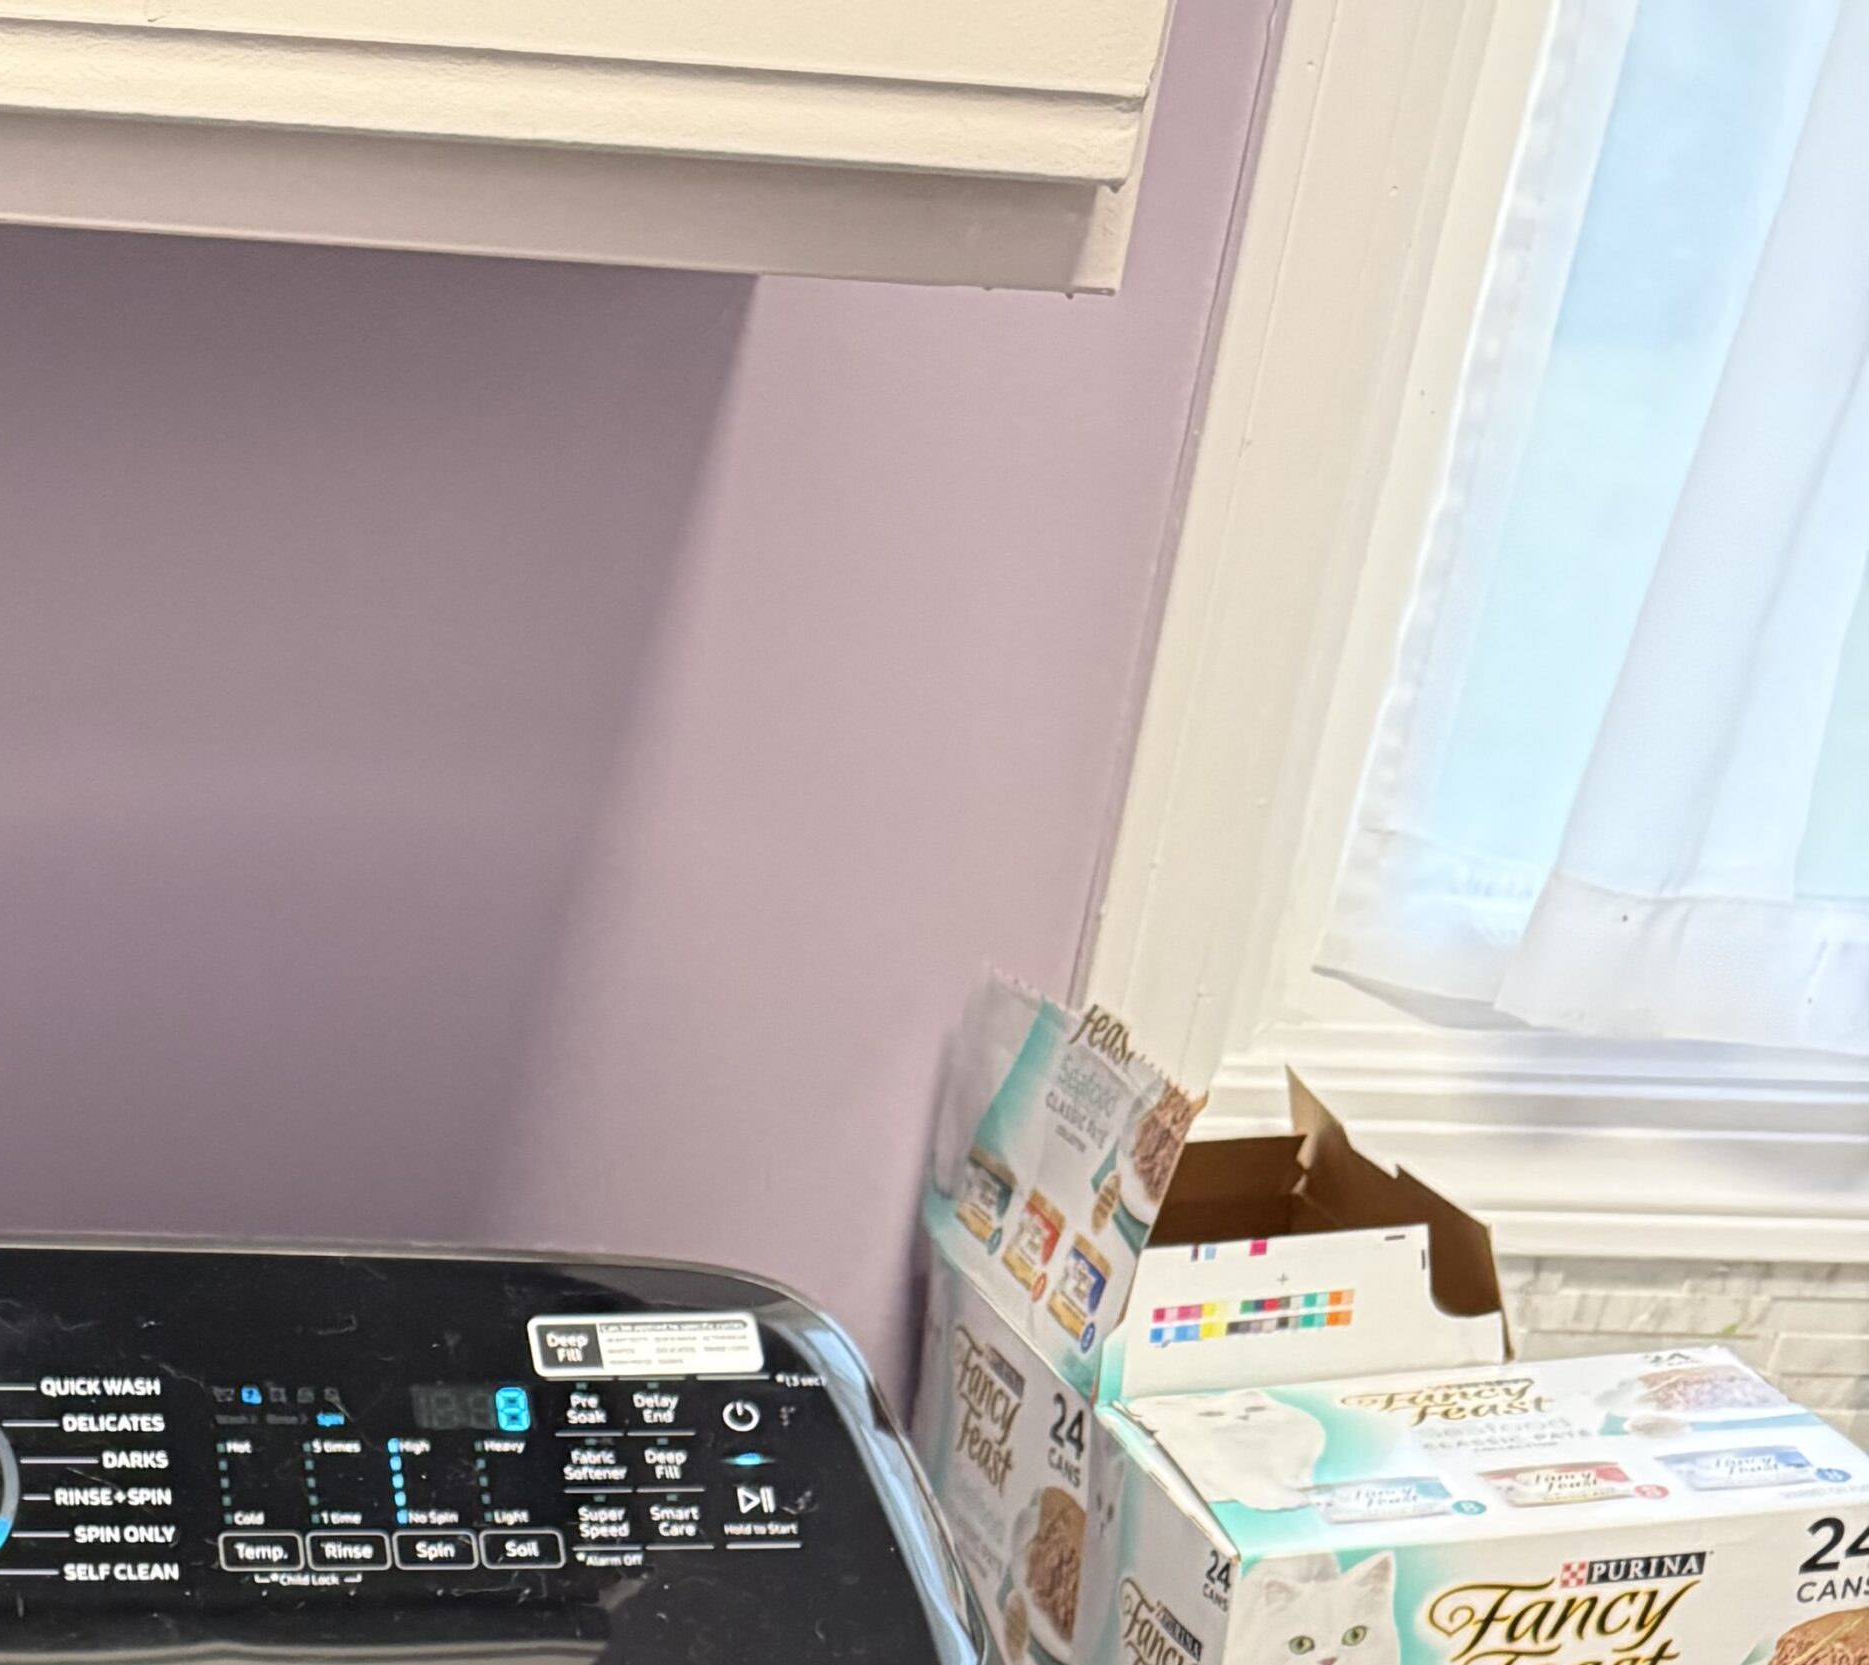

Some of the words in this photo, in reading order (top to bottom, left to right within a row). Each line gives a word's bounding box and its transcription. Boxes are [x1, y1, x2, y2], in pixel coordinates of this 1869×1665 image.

[546, 1332, 589, 1349] Deep
[557, 1347, 582, 1362] Fill
[40, 1378, 98, 1397] QUICK
[103, 1378, 161, 1396] WASH
[570, 1393, 599, 1408] Pre
[633, 1393, 679, 1410] Delay
[62, 1415, 166, 1433] DELICATES
[567, 1409, 607, 1424] Soak
[643, 1409, 675, 1423] End
[1049, 1392, 1085, 1460] 24
[226, 1440, 251, 1454] Hot
[400, 1440, 430, 1455] High
[483, 1440, 525, 1454] Heavy
[101, 1451, 169, 1470] DARKS
[571, 1450, 615, 1465] Fabric
[644, 1449, 687, 1466] Deep
[563, 1466, 627, 1481] Softener
[655, 1465, 682, 1480] Fill
[1048, 1447, 1081, 1489] CANS
[234, 1512, 264, 1526] Cold
[408, 1512, 427, 1525] No
[429, 1512, 459, 1526] Spin
[494, 1512, 529, 1527] Light
[578, 1506, 626, 1523] Super
[649, 1505, 700, 1521] Smart
[73, 1525, 124, 1544] SPIN
[127, 1525, 176, 1545] ONLY
[579, 1522, 630, 1539] Speed
[658, 1521, 697, 1537] Care
[724, 1523, 753, 1535] Hold
[767, 1522, 798, 1535] Start
[234, 1542, 288, 1561] Temp.
[324, 1541, 373, 1560] Rinse
[416, 1541, 455, 1561] Spin
[504, 1539, 540, 1558] Soil
[586, 1553, 622, 1566] Alarm
[623, 1552, 644, 1566] Off
[63, 1562, 108, 1581] SELF
[113, 1562, 179, 1581] CLEAN
[1206, 1550, 1231, 1592] 24
[1591, 1553, 1703, 1584] PURINA
[1428, 1577, 1701, 1663] Fancy
